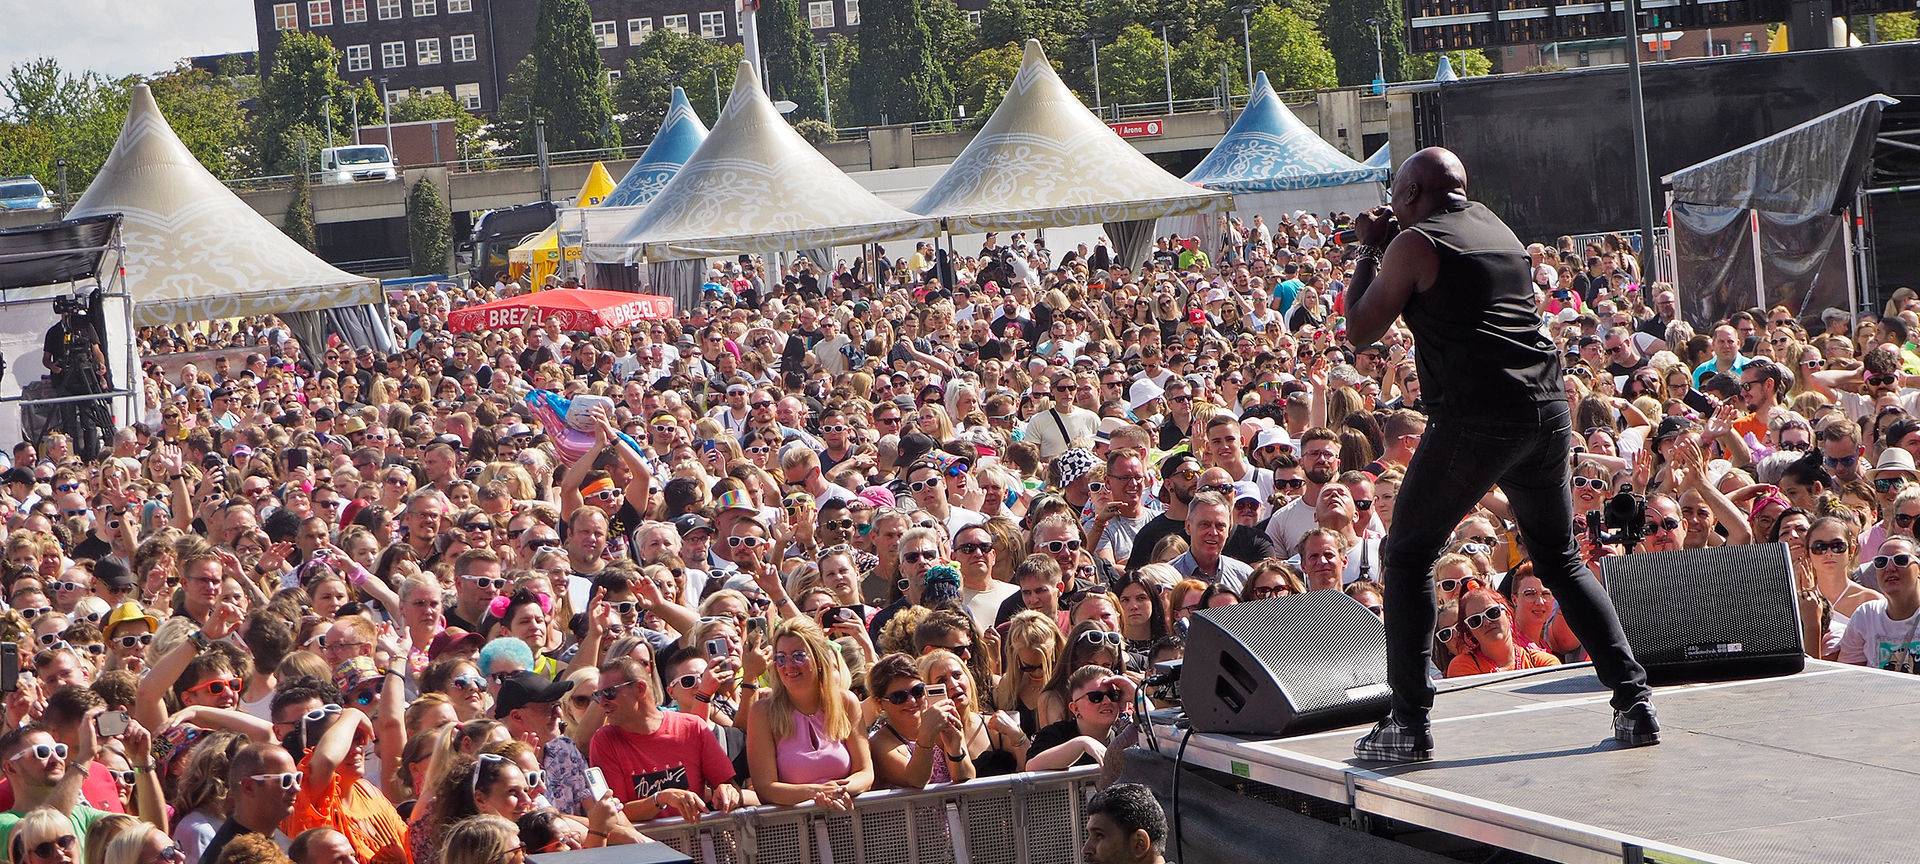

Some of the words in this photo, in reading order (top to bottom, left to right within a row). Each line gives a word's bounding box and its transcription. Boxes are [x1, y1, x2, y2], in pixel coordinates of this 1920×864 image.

[1123, 126, 1143, 134] Arena
[489, 307, 546, 327] BREZEL
[614, 300, 658, 324] BREZEL
